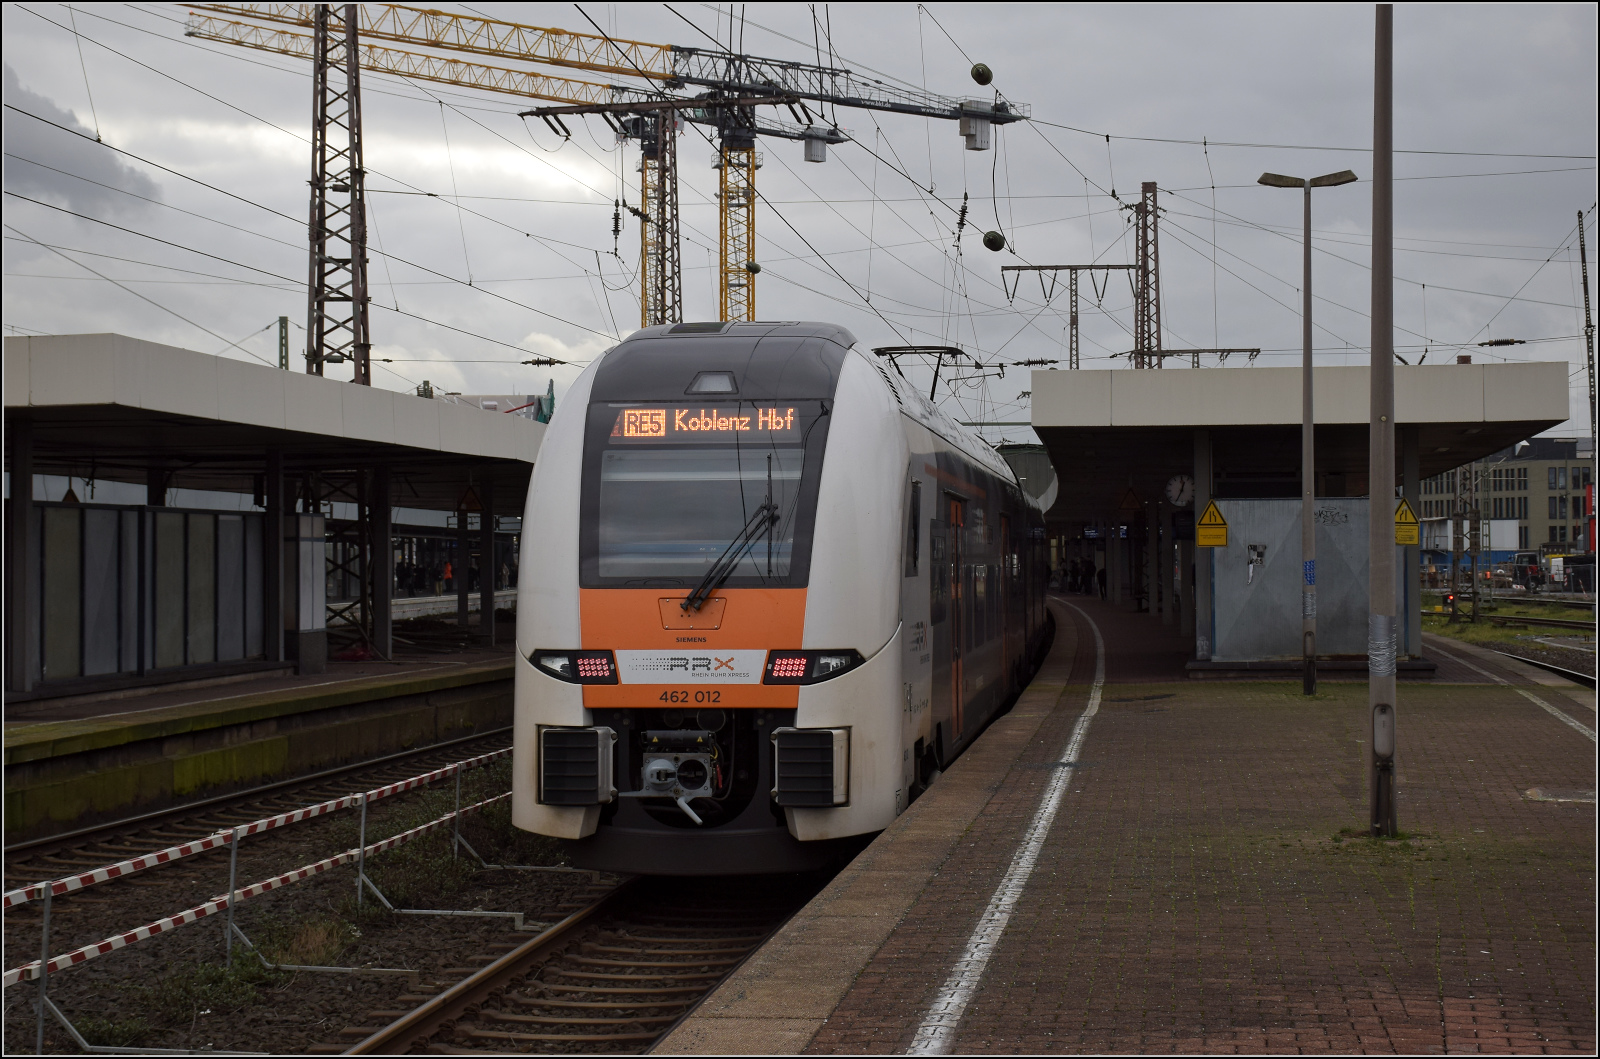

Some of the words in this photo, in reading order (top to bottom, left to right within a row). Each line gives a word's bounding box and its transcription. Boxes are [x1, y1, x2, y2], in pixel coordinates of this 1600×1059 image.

[921, 107, 951, 116] www.bkl.de
[626, 412, 662, 434] RE5
[674, 409, 751, 431] Koblenz
[758, 408, 794, 431] Hbf
[670, 657, 735, 671] RRX
[659, 690, 689, 704] 462
[695, 690, 721, 704] 012
